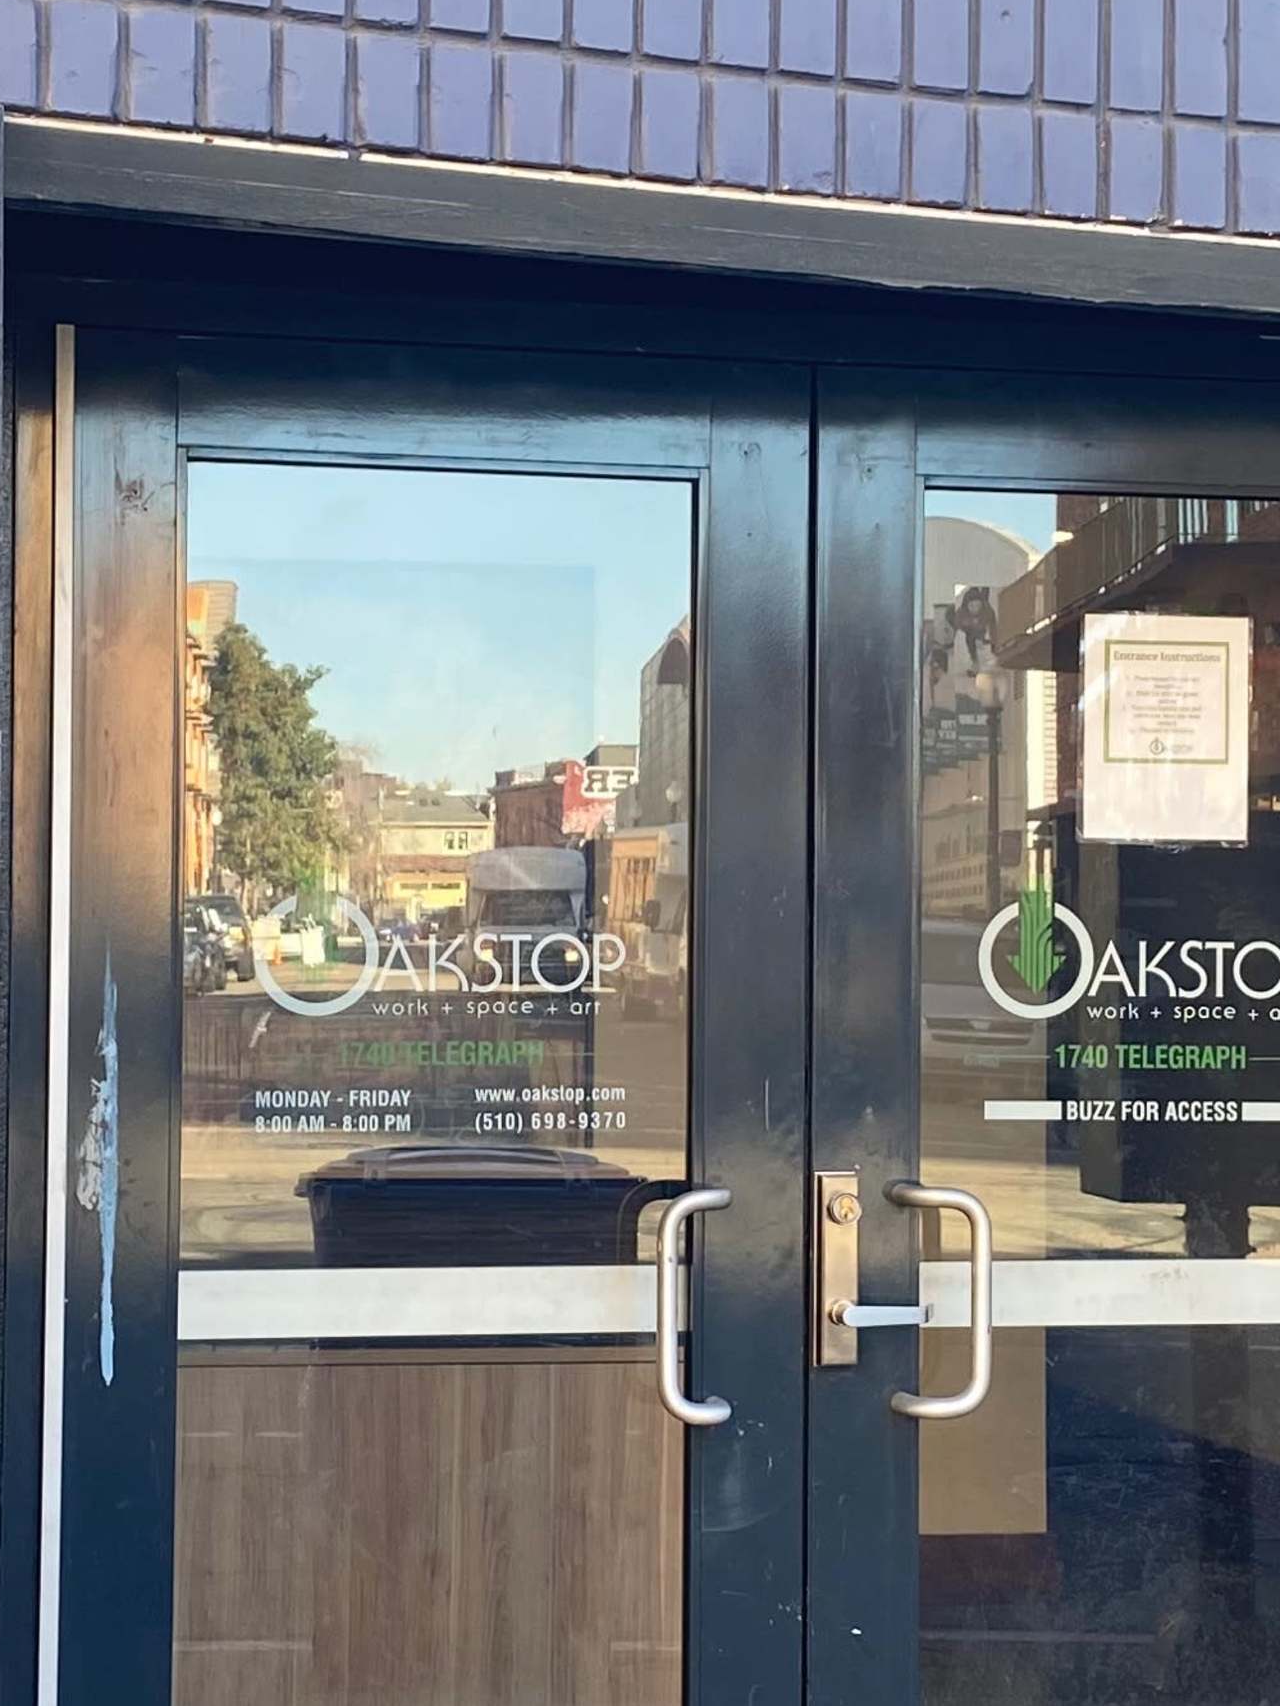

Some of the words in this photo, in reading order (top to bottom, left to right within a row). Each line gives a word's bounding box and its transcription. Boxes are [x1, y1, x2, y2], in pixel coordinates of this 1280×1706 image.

[1113, 650, 1158, 661] Entrance
[1160, 651, 1221, 663] Instructions
[254, 893, 627, 1016] OAKSTOP
[372, 998, 429, 1015] work
[466, 999, 534, 1018] space
[570, 999, 601, 1016] art
[1086, 1003, 1140, 1020] work
[1173, 1005, 1237, 1024] space
[339, 1041, 395, 1067] 1740
[403, 1040, 545, 1067] TELEGRAPH
[1054, 1044, 1108, 1069] 1740
[1115, 1044, 1247, 1070] TELEGRAPH
[255, 1090, 331, 1108] MONDAY
[349, 1089, 412, 1107] FRIDAY
[474, 1084, 626, 1105] www.oakstop.com
[1066, 1100, 1116, 1121] BUZZ
[1121, 1100, 1160, 1122] FOR
[1164, 1100, 1238, 1122] ACCESS
[255, 1114, 292, 1133] 8:00
[297, 1114, 325, 1133] AM
[342, 1114, 379, 1132] 8:00
[384, 1114, 411, 1132] PM
[474, 1112, 524, 1134] (510)
[531, 1111, 626, 1130] 698-9370
